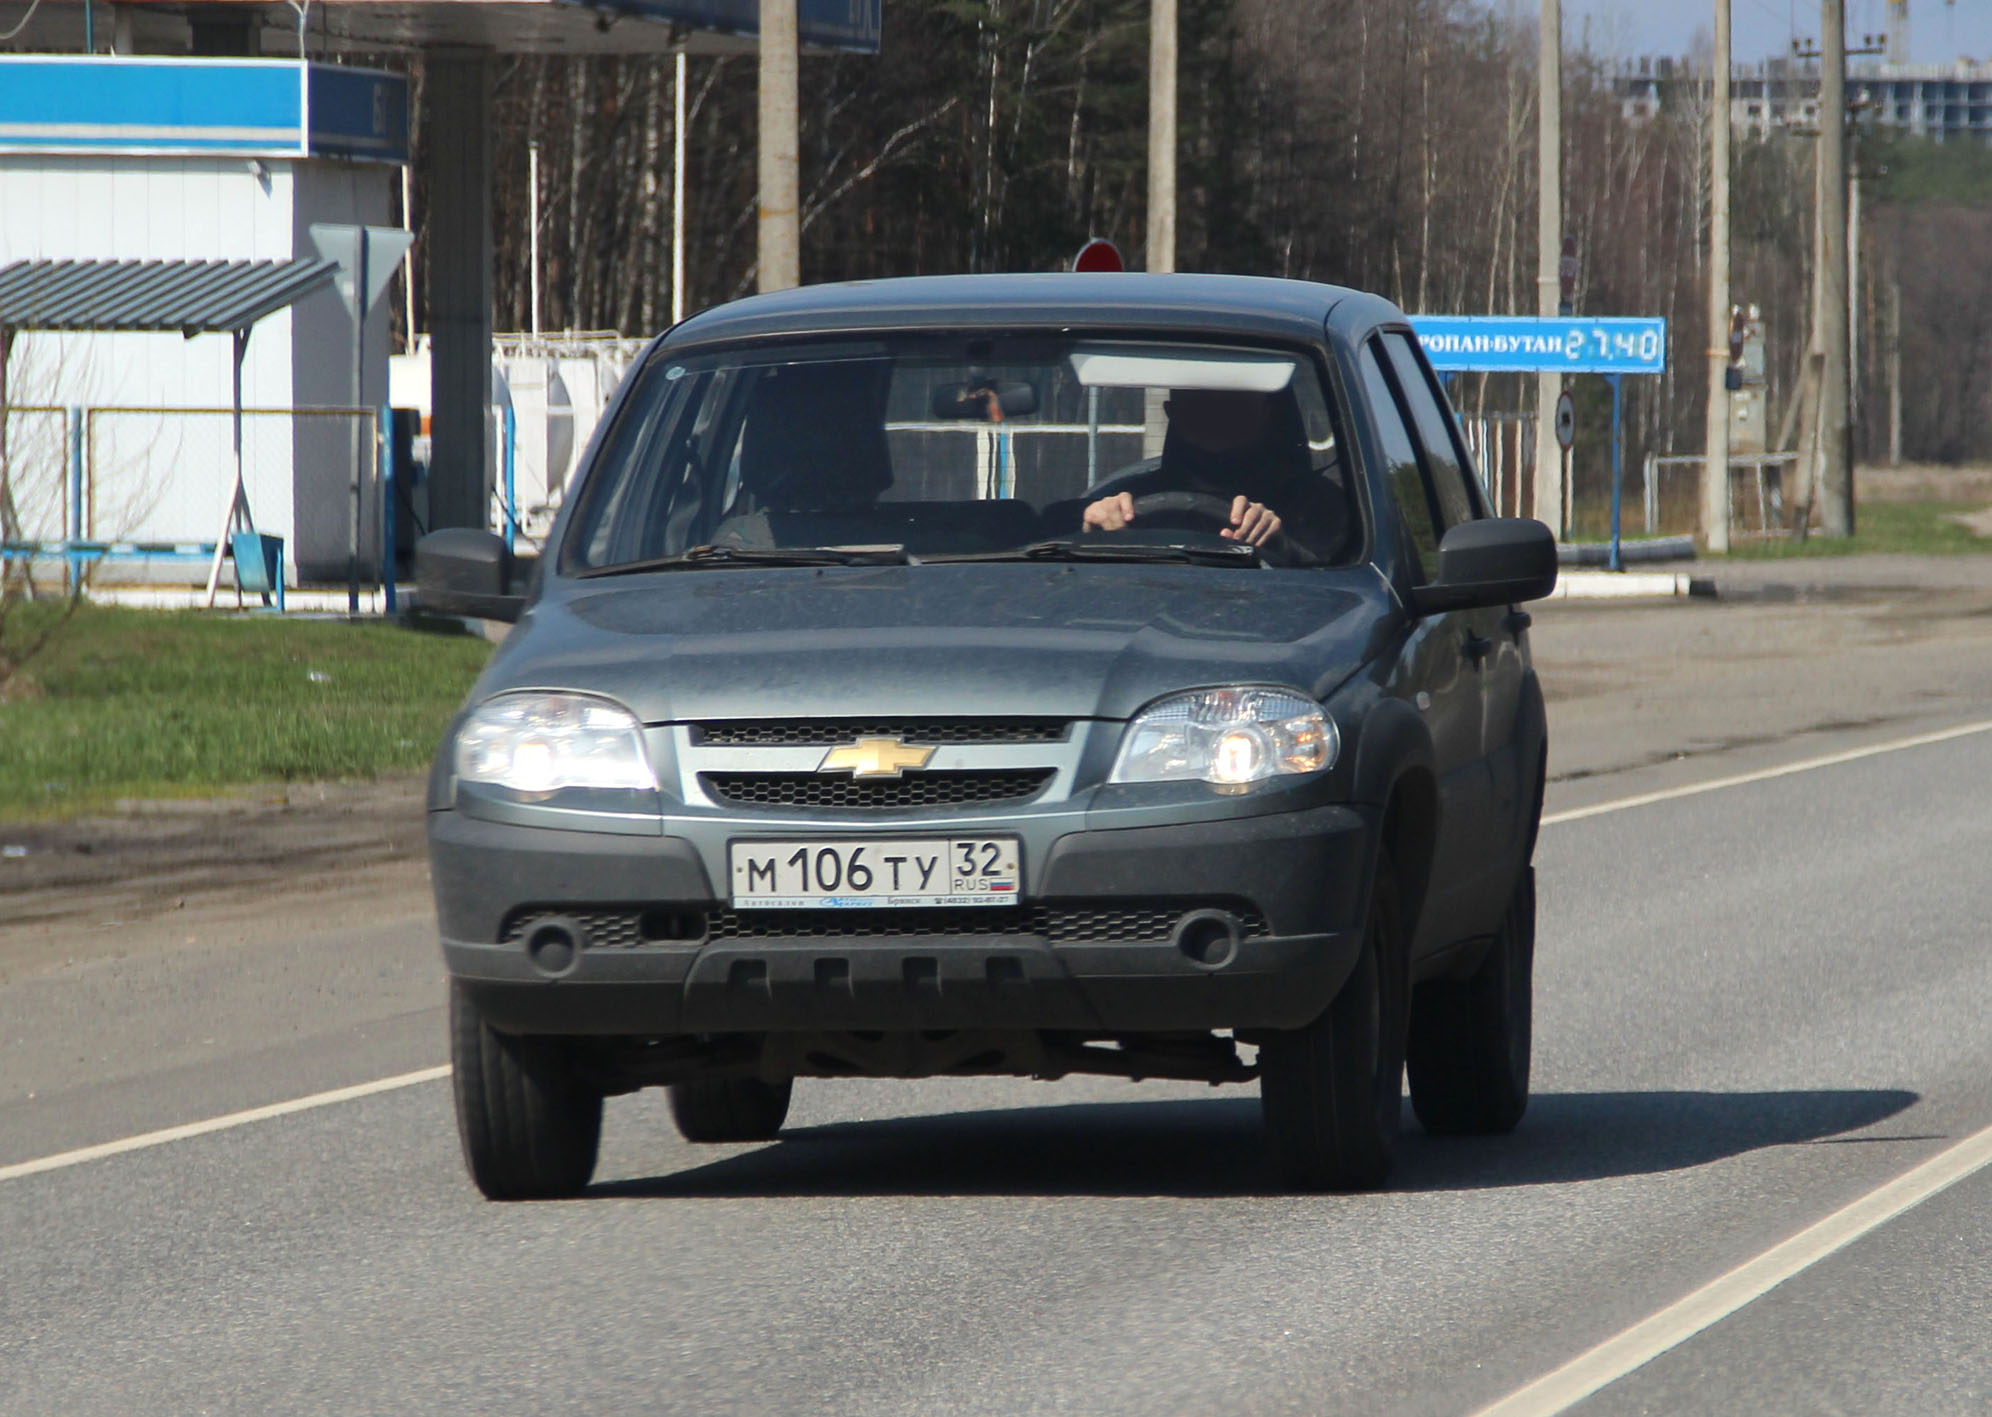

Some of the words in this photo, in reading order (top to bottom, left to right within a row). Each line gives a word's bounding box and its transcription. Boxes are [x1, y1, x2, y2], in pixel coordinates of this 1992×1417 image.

[1417, 334, 1562, 354] РОПАН-БУТАН
[956, 842, 1002, 876] 32
[955, 878, 988, 891] RUS
